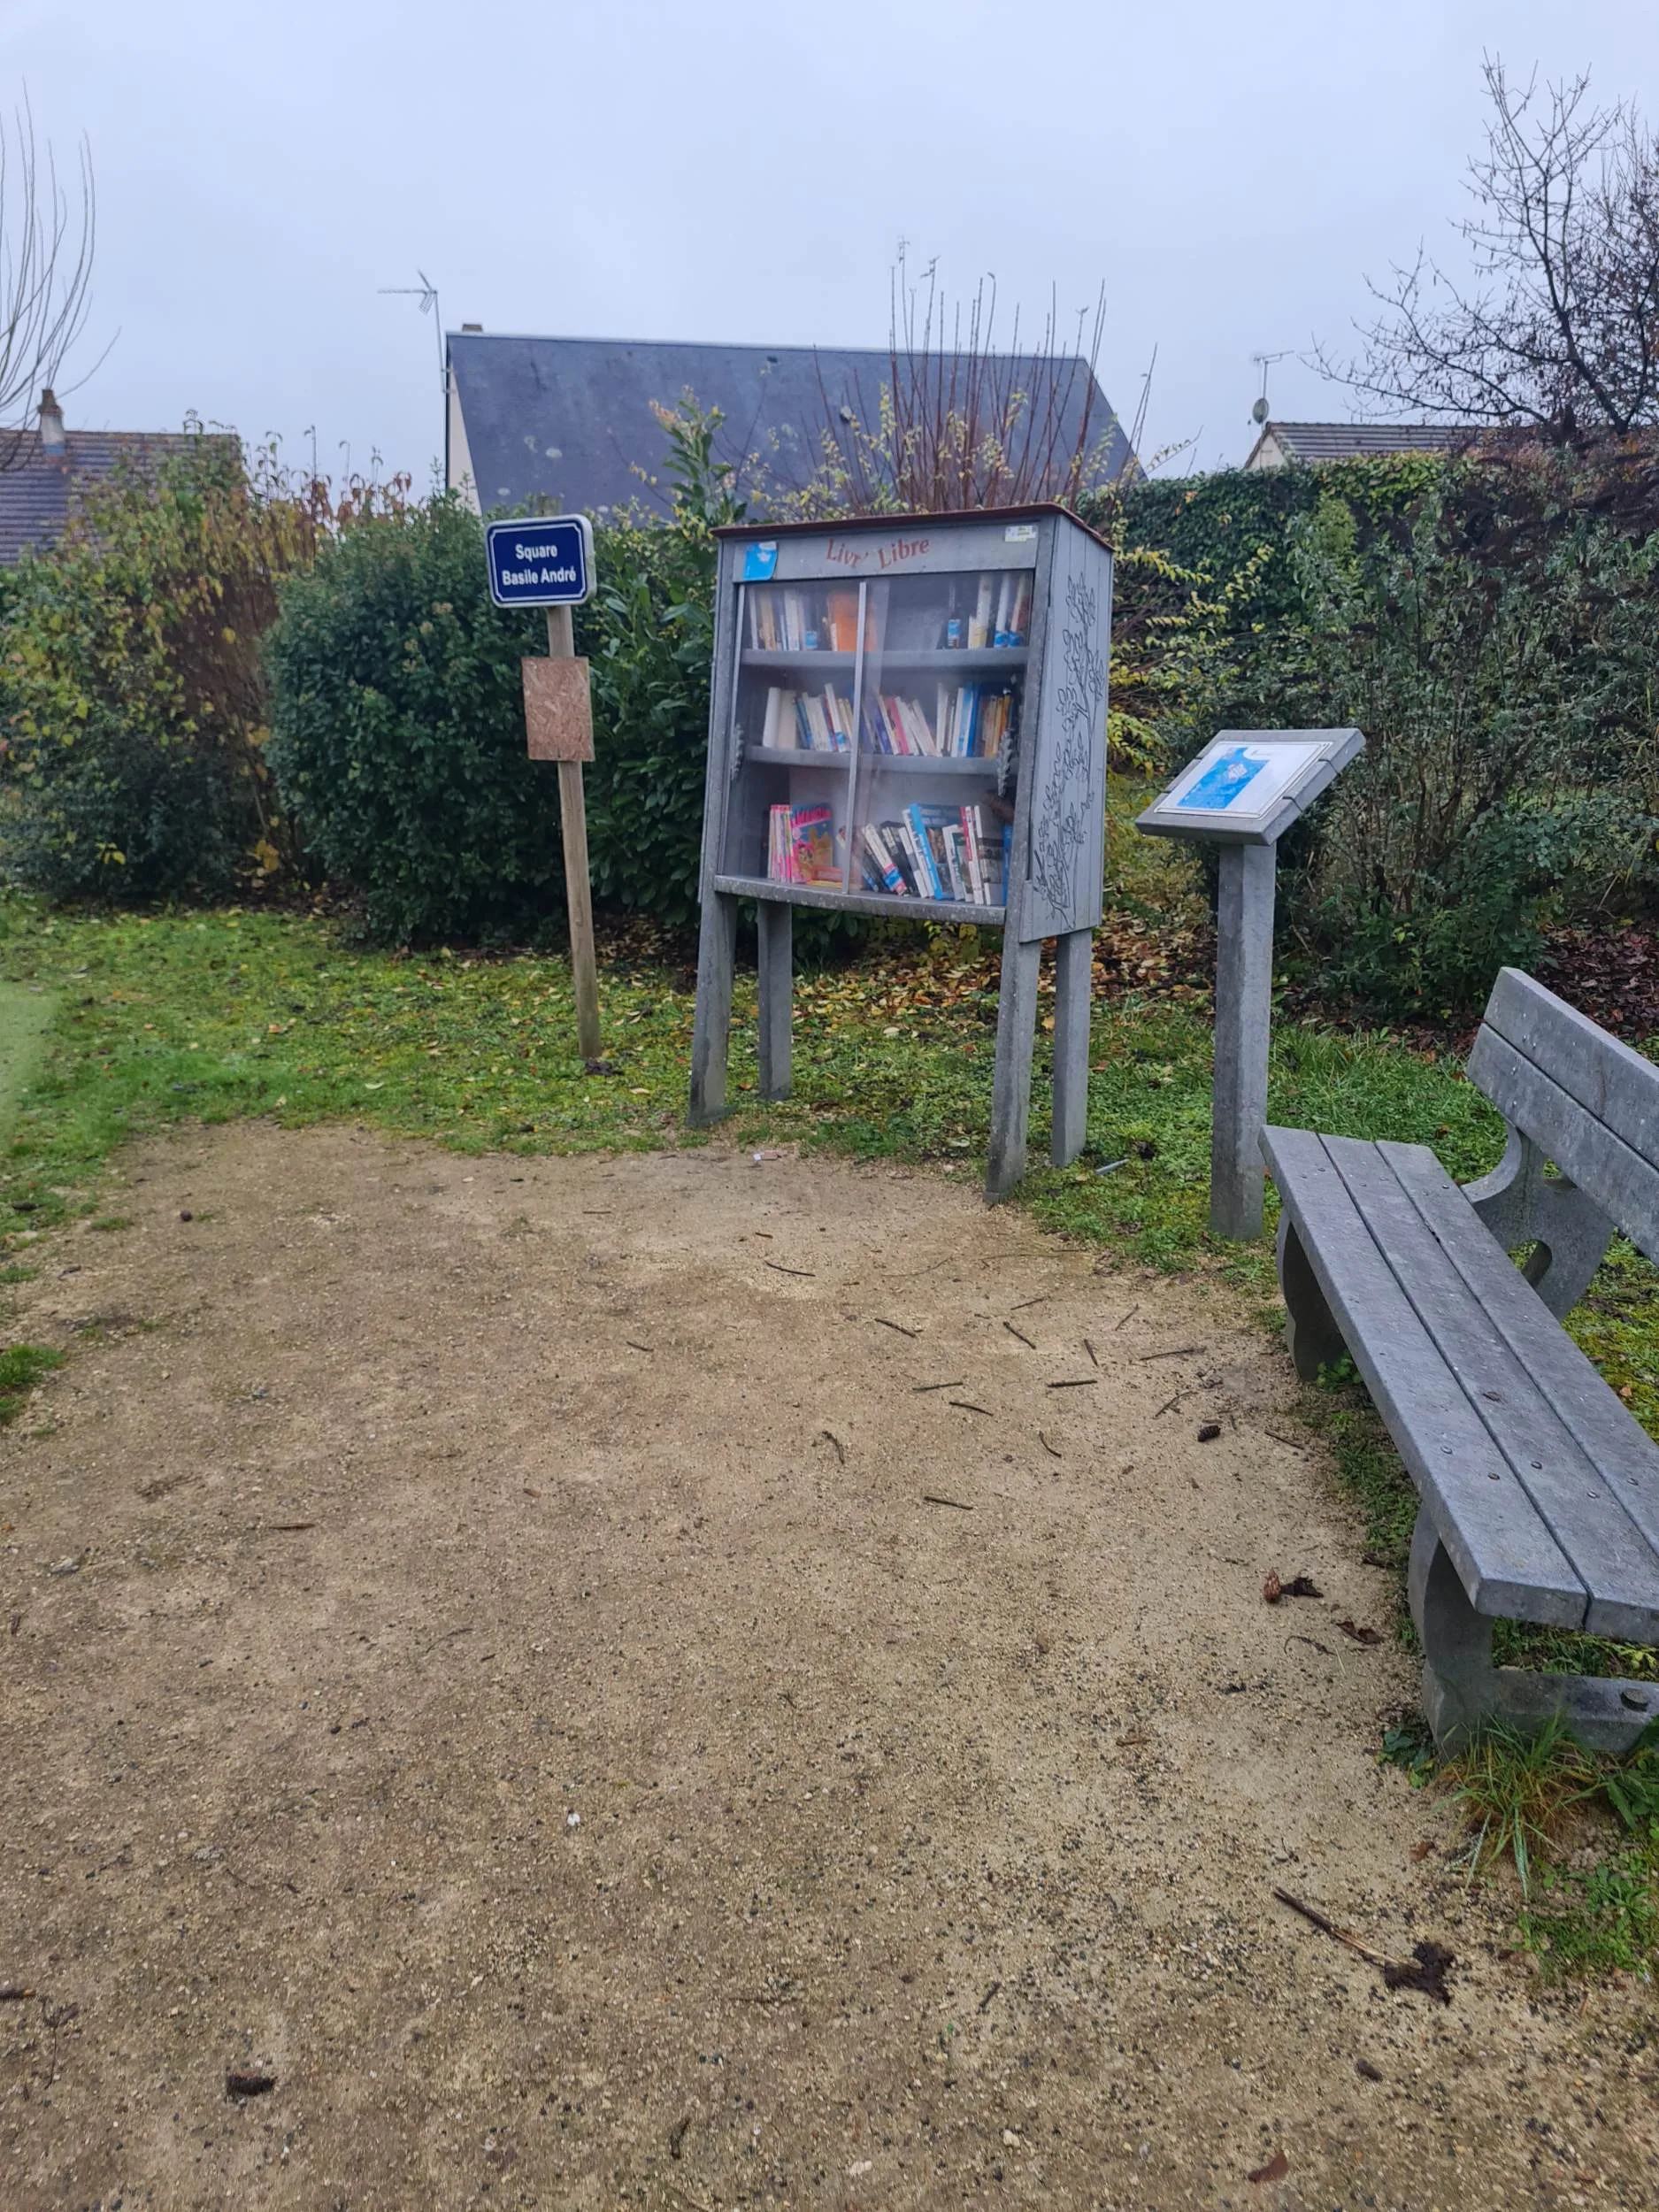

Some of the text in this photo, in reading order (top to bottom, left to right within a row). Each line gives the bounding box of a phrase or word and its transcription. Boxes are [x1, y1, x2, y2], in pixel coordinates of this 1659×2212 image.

[515, 543, 557, 562] Square
[878, 537, 929, 569] Libre
[502, 565, 576, 585] Basile André
